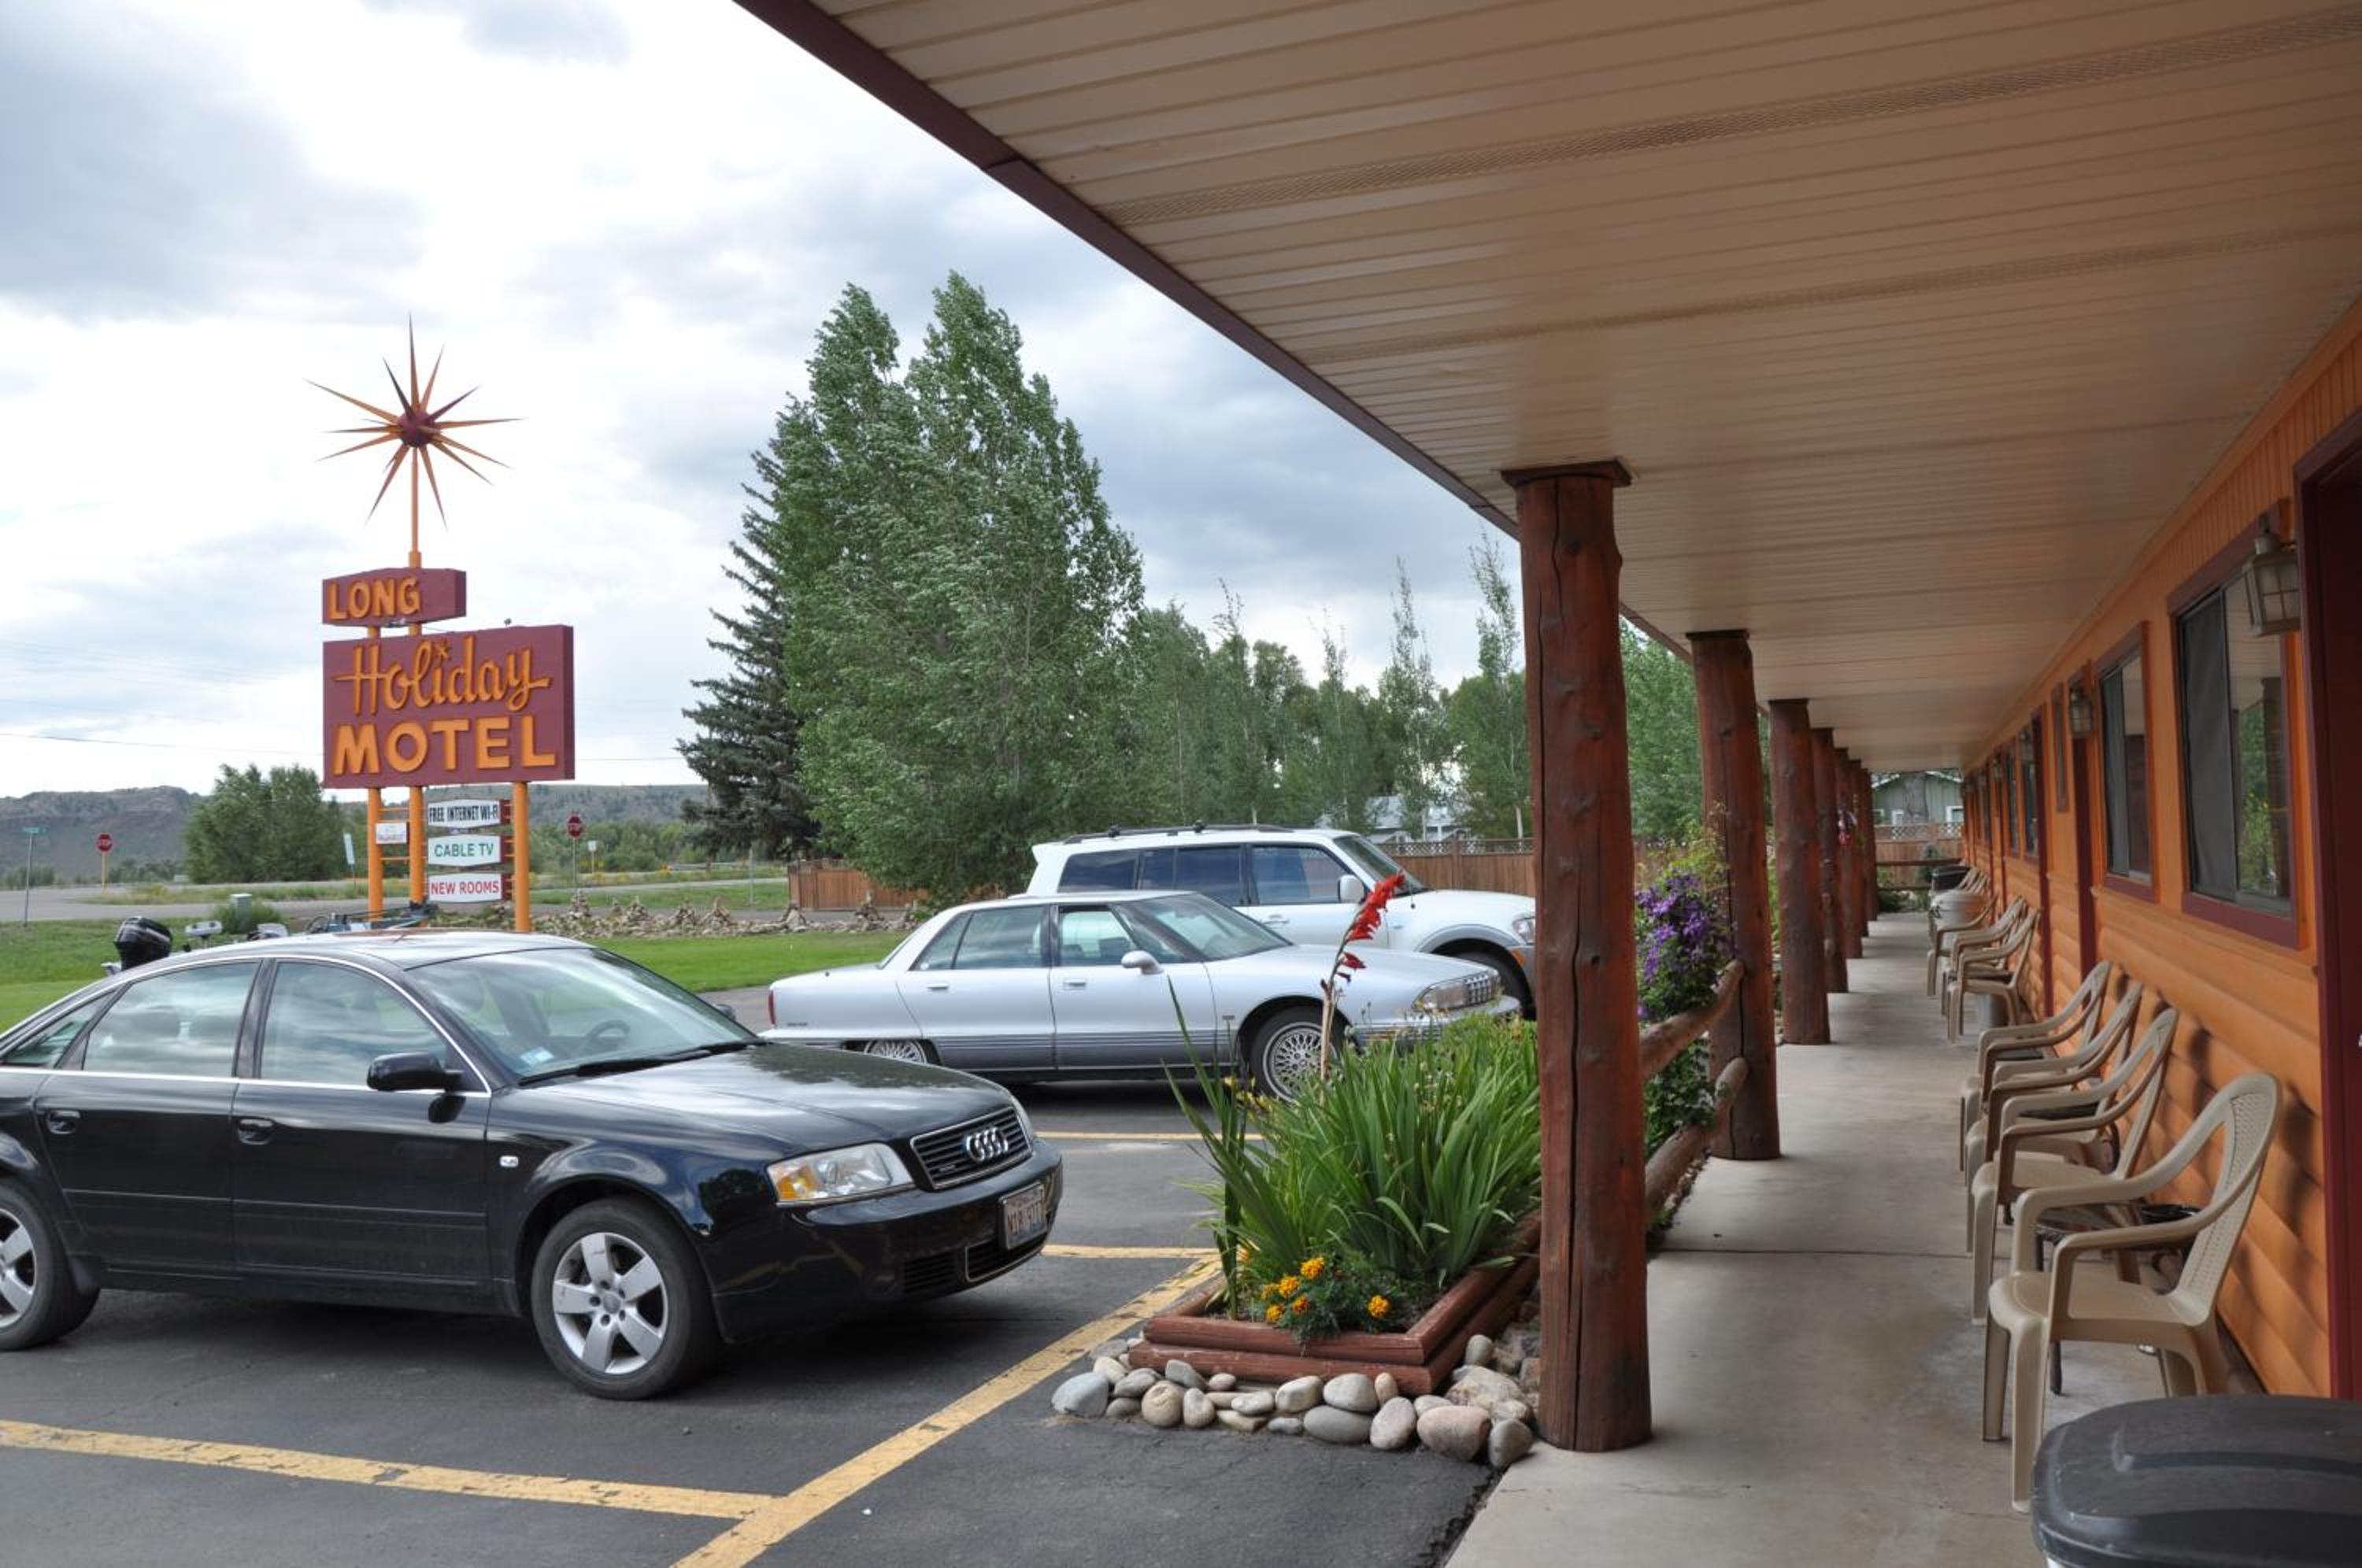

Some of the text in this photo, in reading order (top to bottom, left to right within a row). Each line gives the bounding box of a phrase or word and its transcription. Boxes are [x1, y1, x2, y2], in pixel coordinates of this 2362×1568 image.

[327, 577, 420, 620] LONG
[332, 634, 553, 716] Holiday
[332, 715, 557, 775] MOTEL
[429, 806, 445, 823] FREE
[447, 804, 479, 821] INTERNET
[434, 843, 494, 857] CABLE TV
[431, 881, 499, 895] NEW ROOMS
